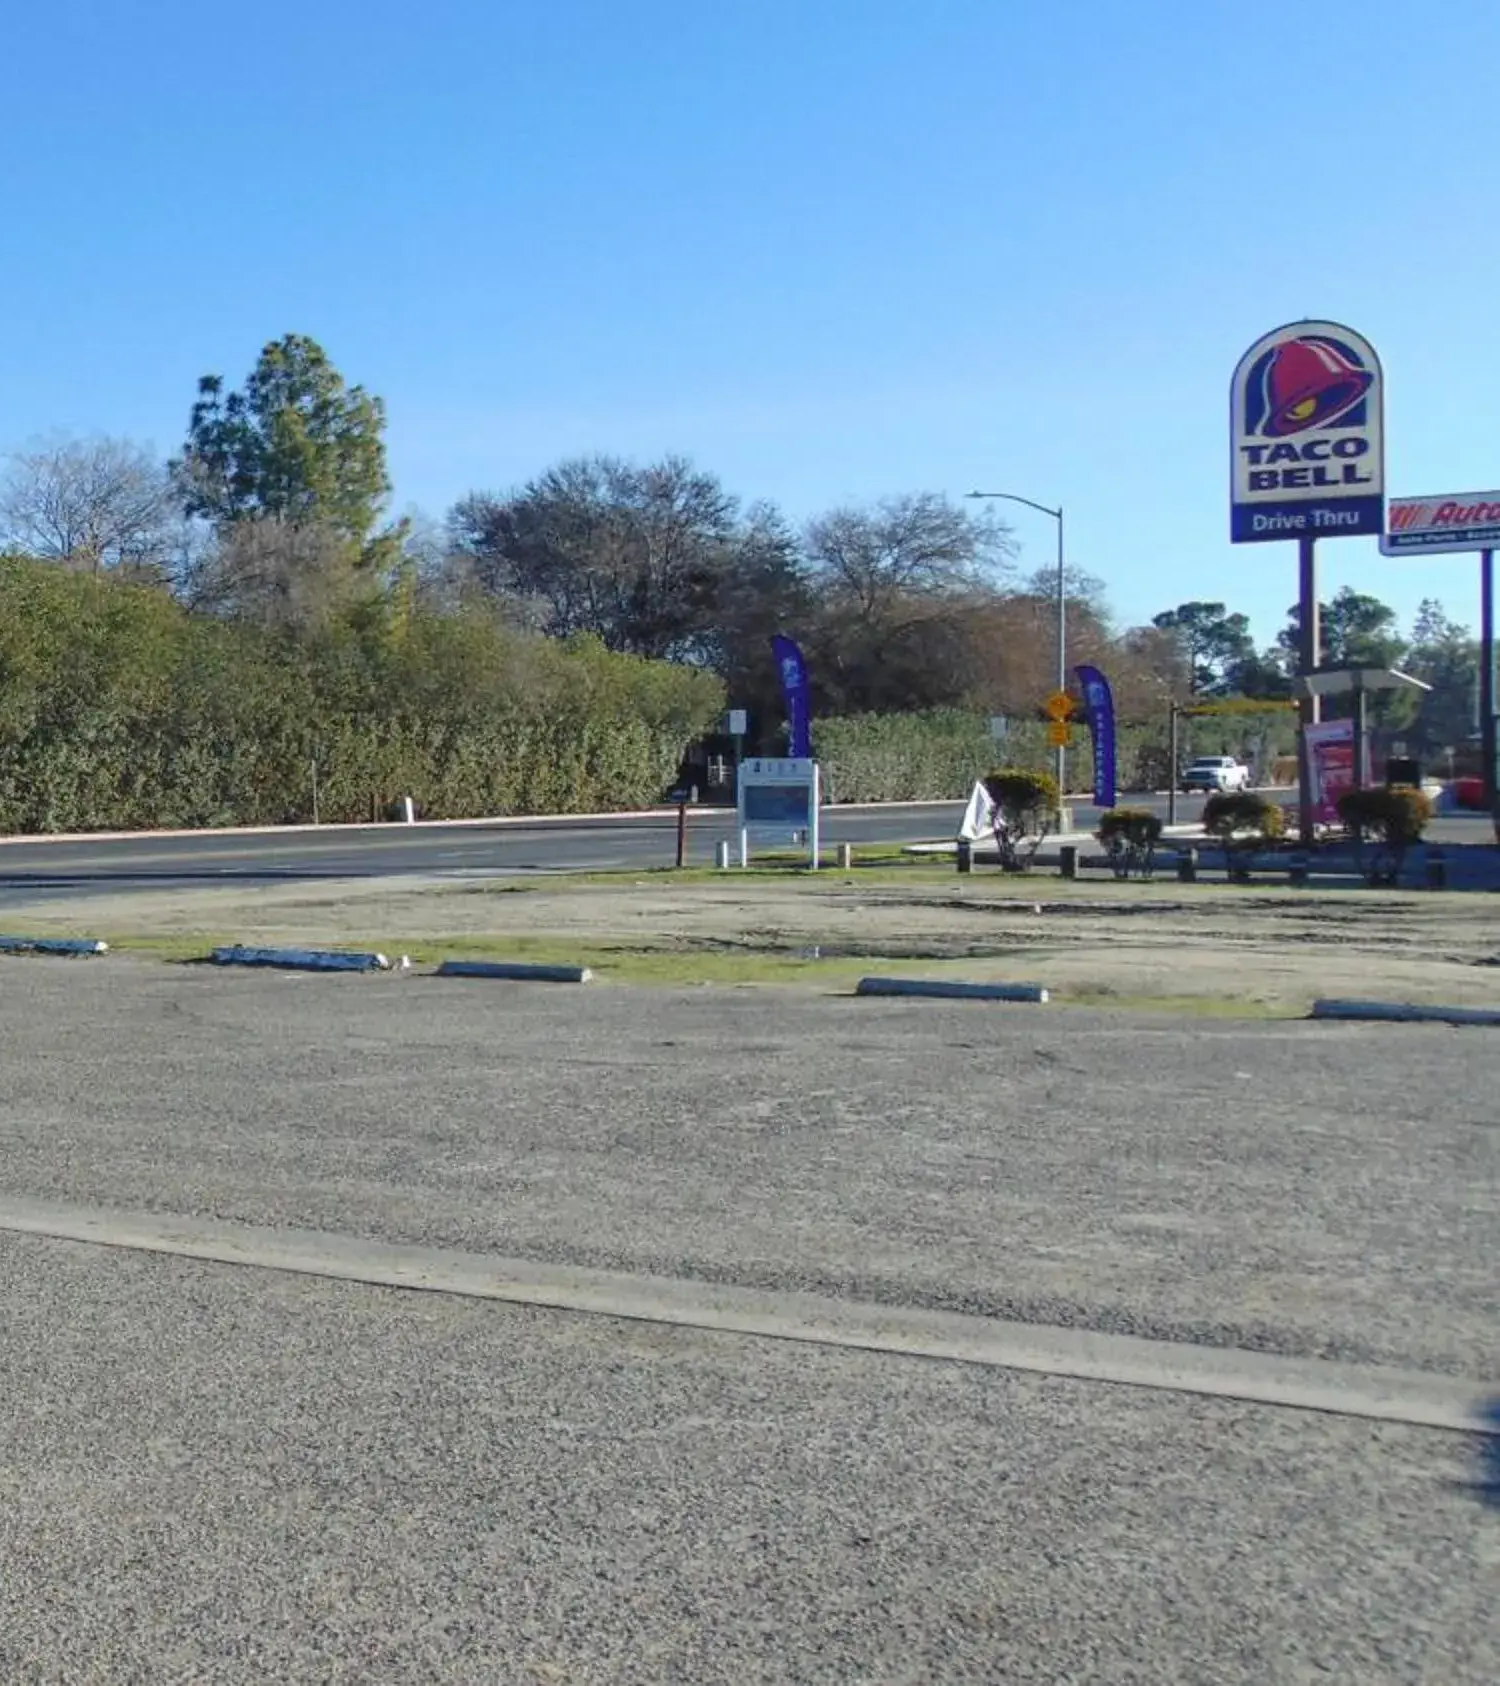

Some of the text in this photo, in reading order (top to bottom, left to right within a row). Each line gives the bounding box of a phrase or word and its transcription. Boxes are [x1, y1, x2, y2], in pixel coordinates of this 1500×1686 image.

[1240, 437, 1369, 465] TACO
[1248, 464, 1372, 492] BELL
[1252, 509, 1360, 532] Drive Thru
